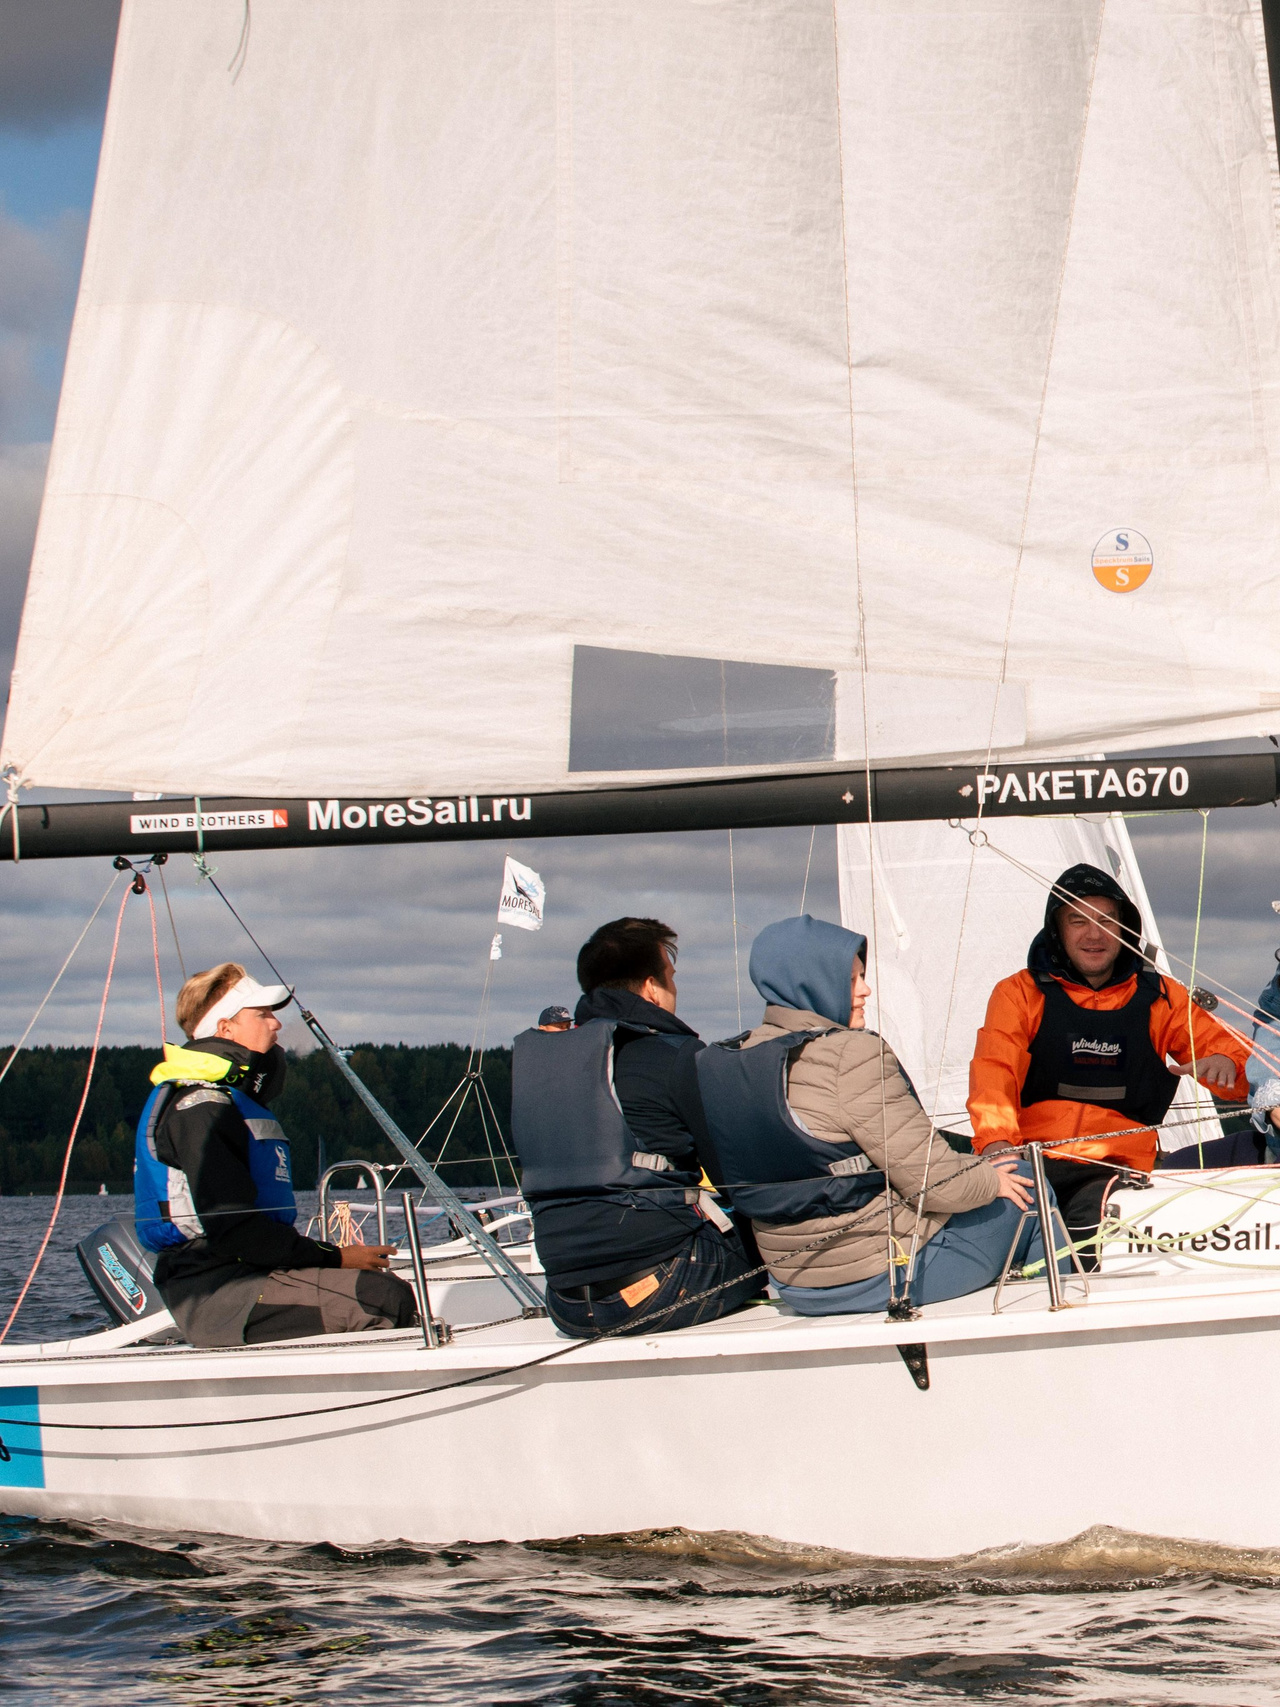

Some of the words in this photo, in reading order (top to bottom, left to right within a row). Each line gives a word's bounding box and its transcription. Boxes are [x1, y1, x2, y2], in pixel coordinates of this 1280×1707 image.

[1115, 532, 1129, 552] S
[1115, 567, 1130, 587] S
[138, 818, 180, 829] WIND
[186, 814, 266, 828] BROTHERS
[307, 796, 532, 831] MoreSail.ru
